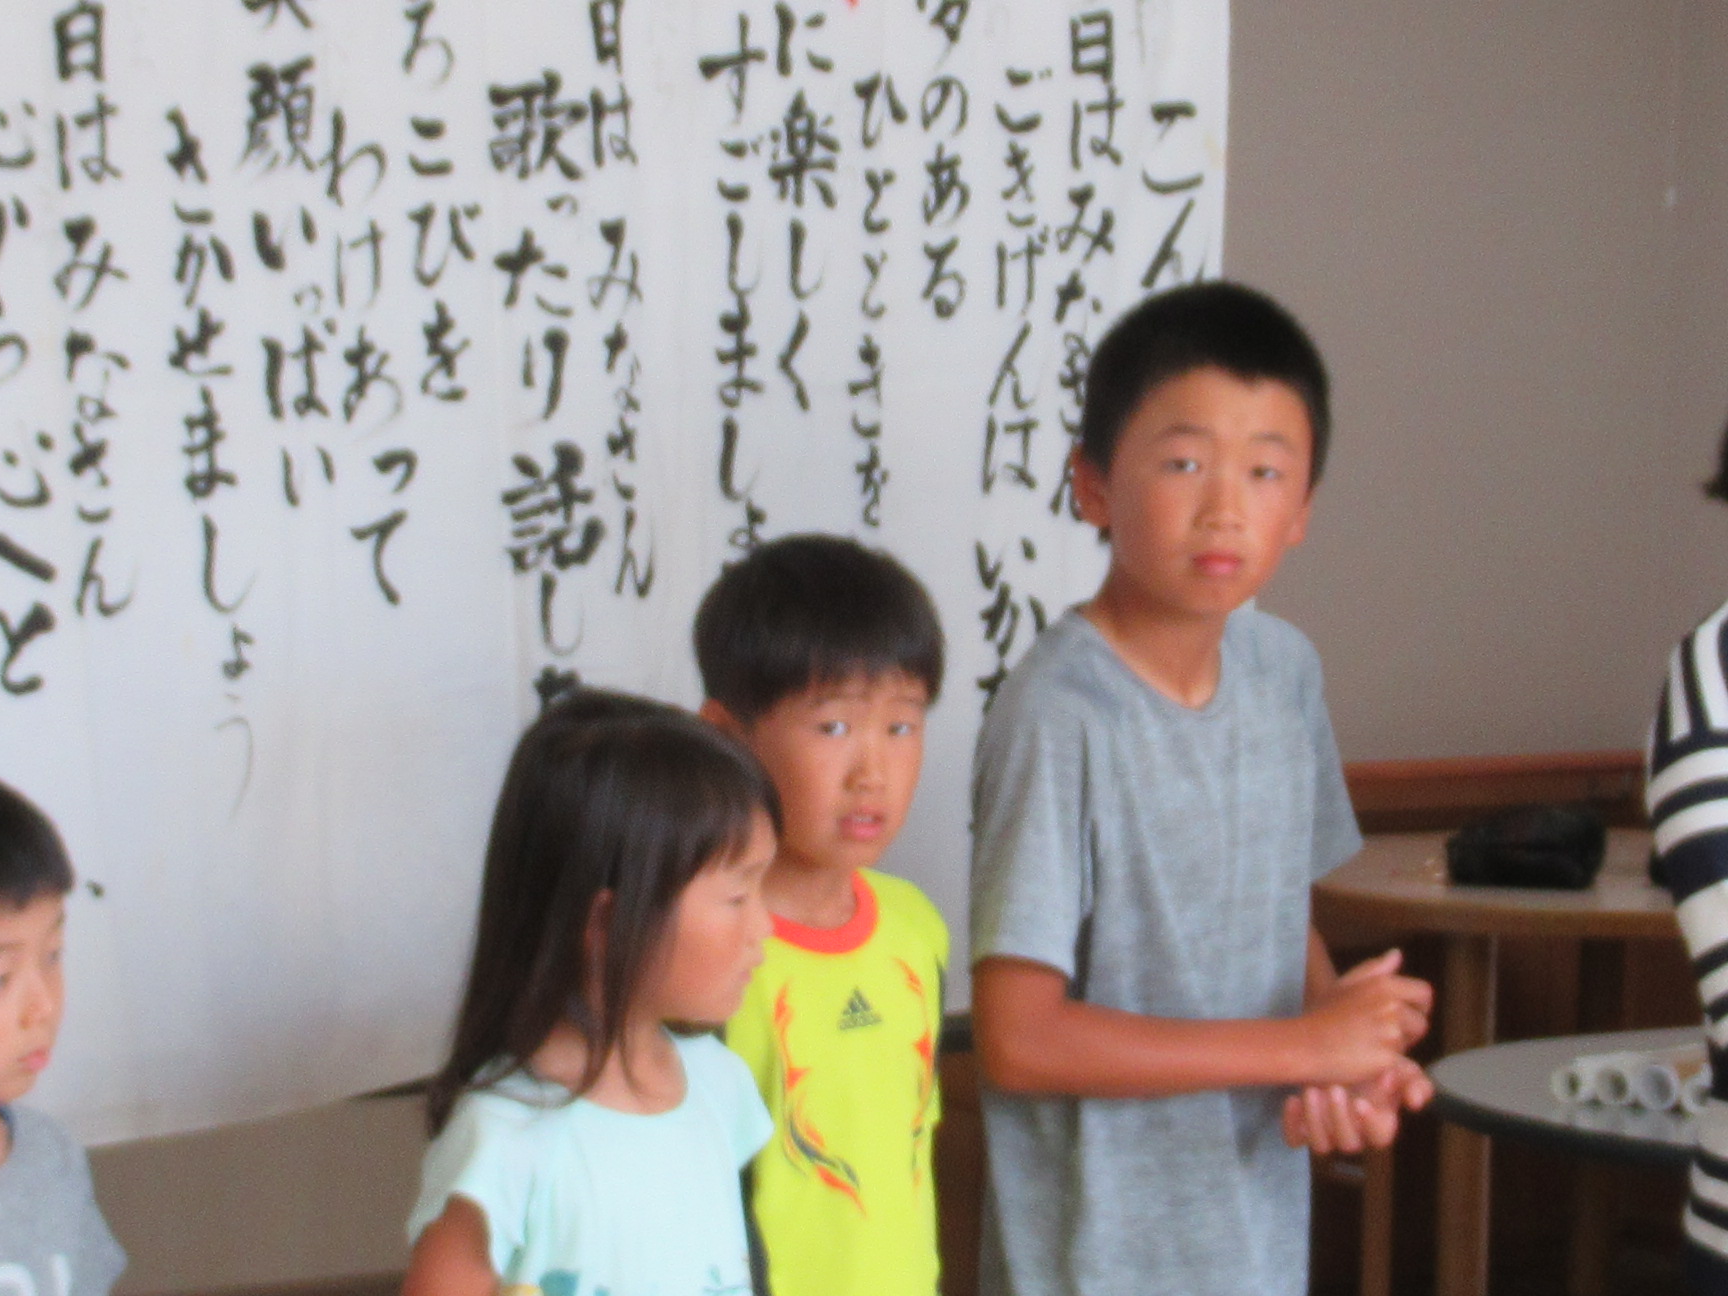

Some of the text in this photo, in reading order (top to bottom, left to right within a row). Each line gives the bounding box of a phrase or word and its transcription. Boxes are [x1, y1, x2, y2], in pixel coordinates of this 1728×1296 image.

[319, 107, 417, 606] わけあって
